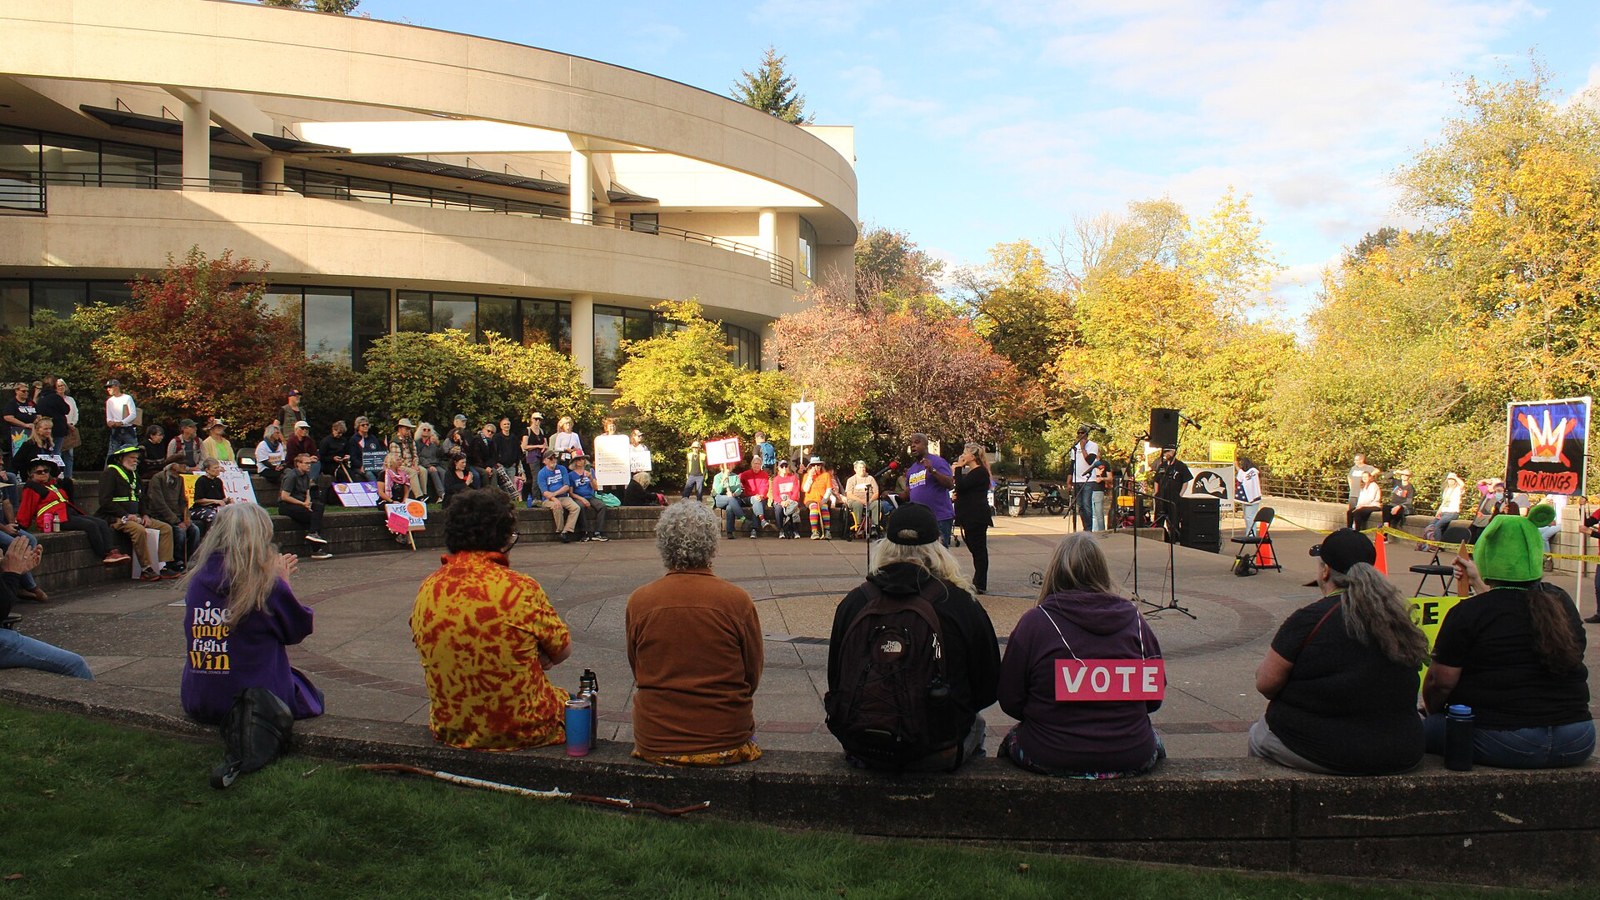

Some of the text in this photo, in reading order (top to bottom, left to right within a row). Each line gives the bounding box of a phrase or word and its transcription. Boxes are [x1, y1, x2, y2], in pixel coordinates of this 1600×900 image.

[1522, 473, 1572, 489] NO KINGS
[192, 600, 231, 626] Rise
[191, 624, 230, 640] unite
[192, 638, 229, 653] fight
[189, 650, 231, 670] Win
[1062, 666, 1159, 693] VOTE
